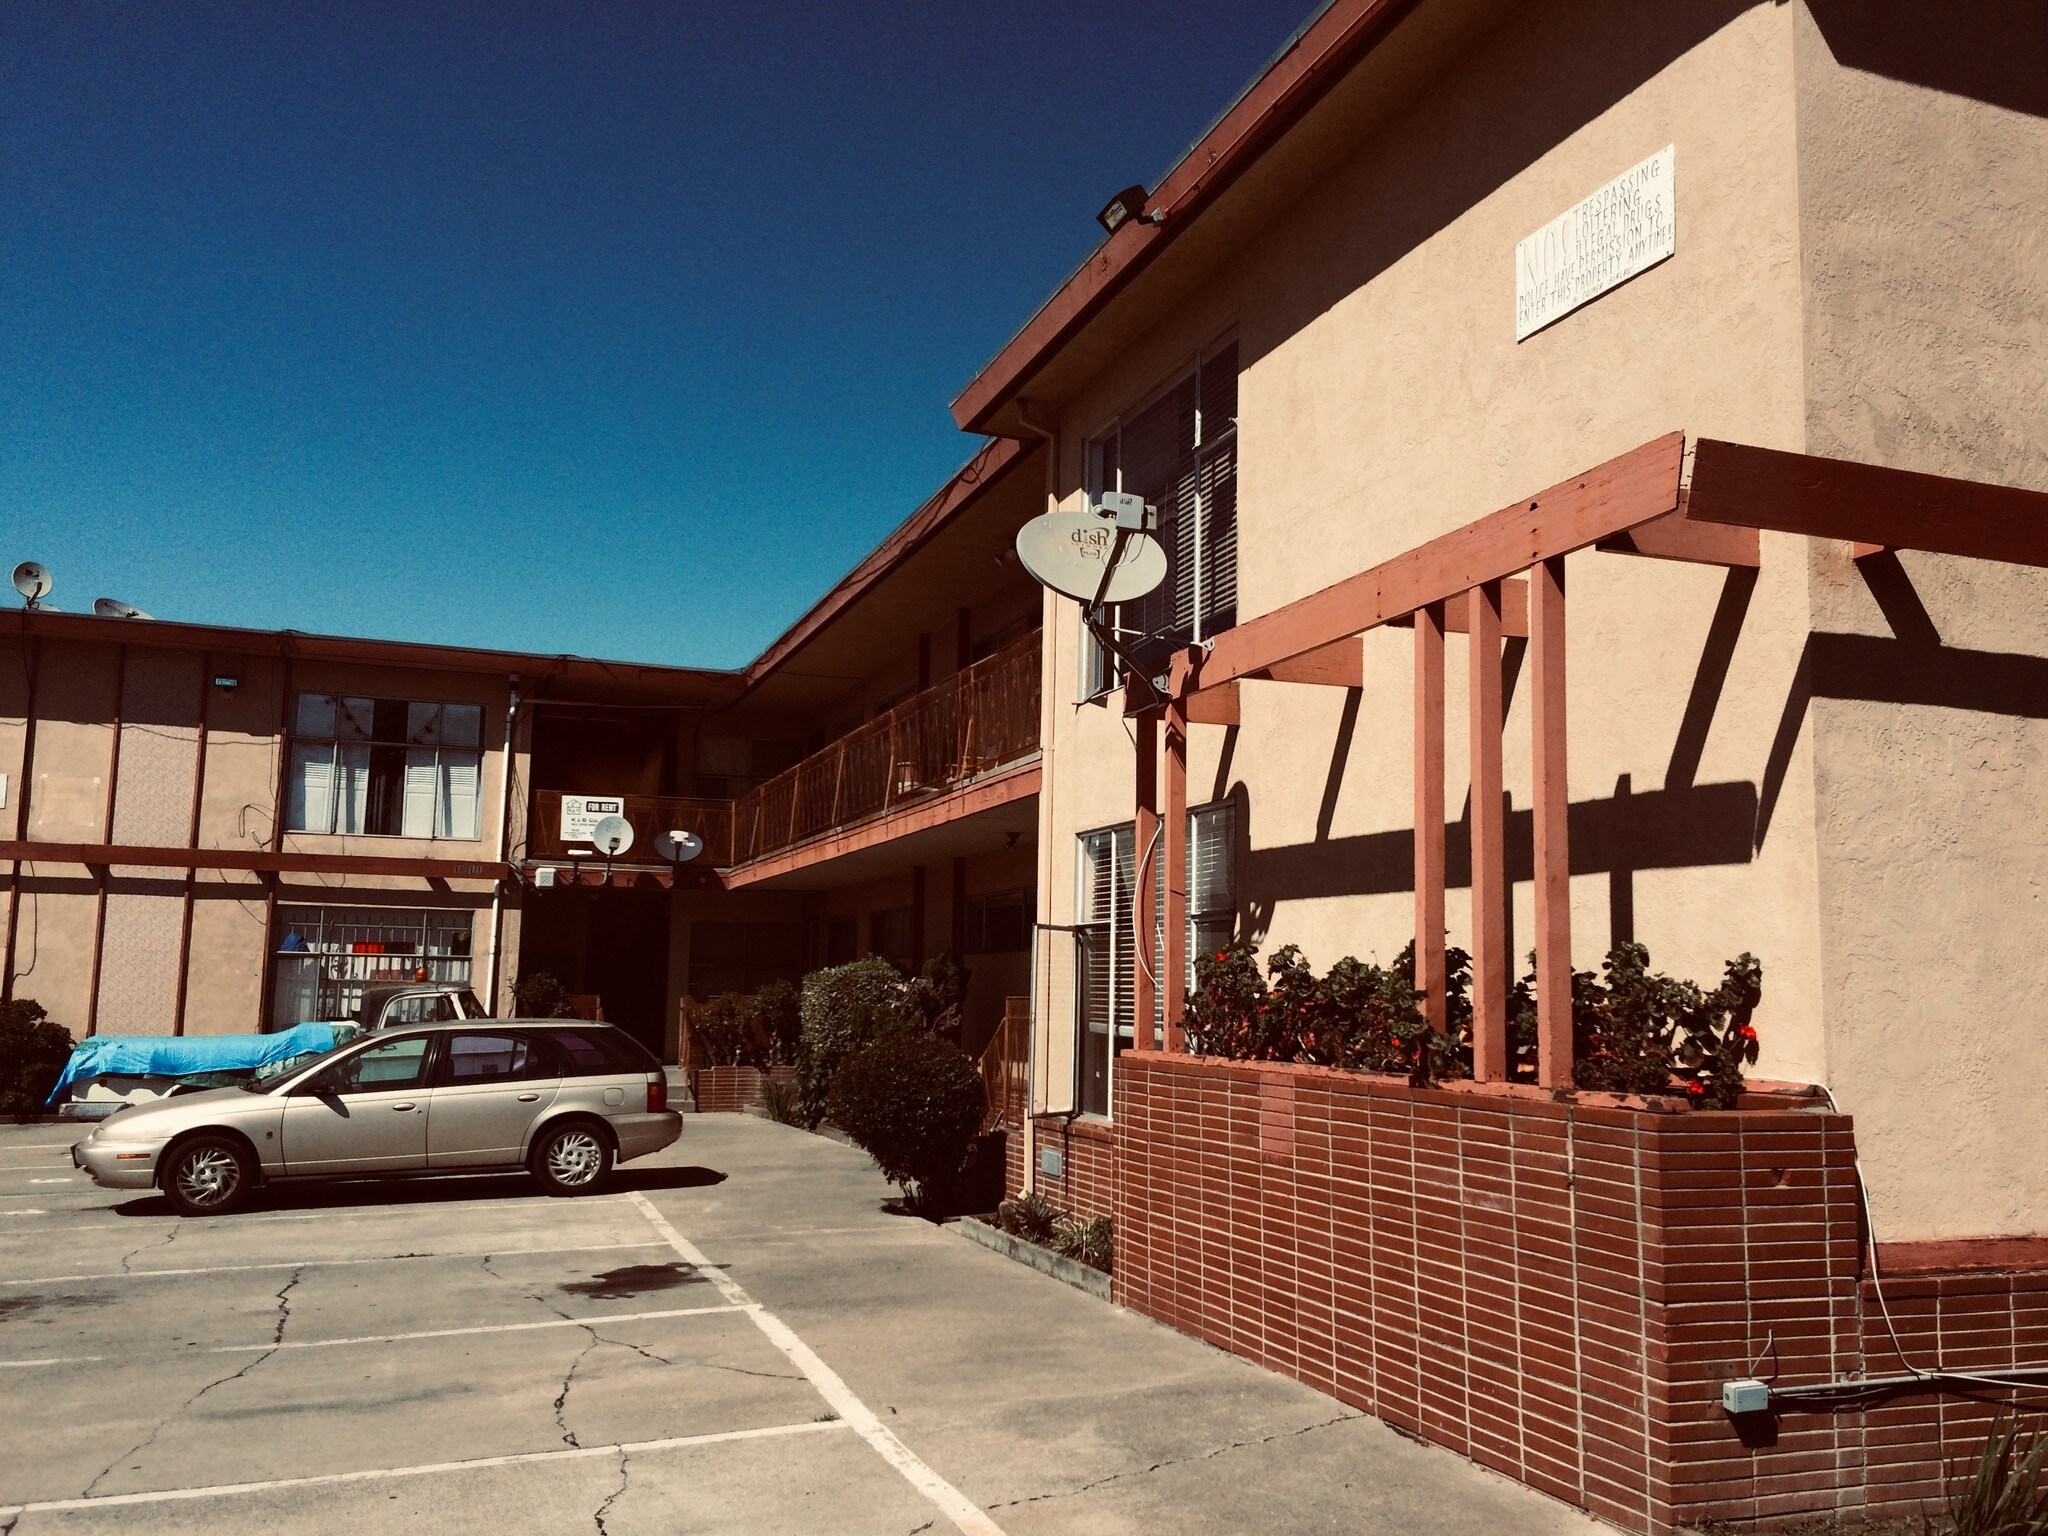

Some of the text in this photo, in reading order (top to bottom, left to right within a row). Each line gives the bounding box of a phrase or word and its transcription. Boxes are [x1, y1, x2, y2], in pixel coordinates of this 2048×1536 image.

[1573, 160, 1661, 225] TRESPASSING
[1575, 188, 1641, 244] LOITERING
[1519, 279, 1549, 309] POLICE
[1554, 262, 1575, 290] HAVE
[1579, 223, 1642, 275] PERMISSION
[1648, 211, 1664, 234] TO
[1523, 226, 1556, 293] NO
[1575, 194, 1661, 262] ILLEGAL DRUGS
[1519, 297, 1546, 328] ENTER
[1551, 281, 1571, 308] THIS
[1576, 251, 1622, 294] PROPERTY
[1071, 527, 1110, 546] dish
[588, 803, 600, 811] FOR
[601, 803, 618, 811] RENT
